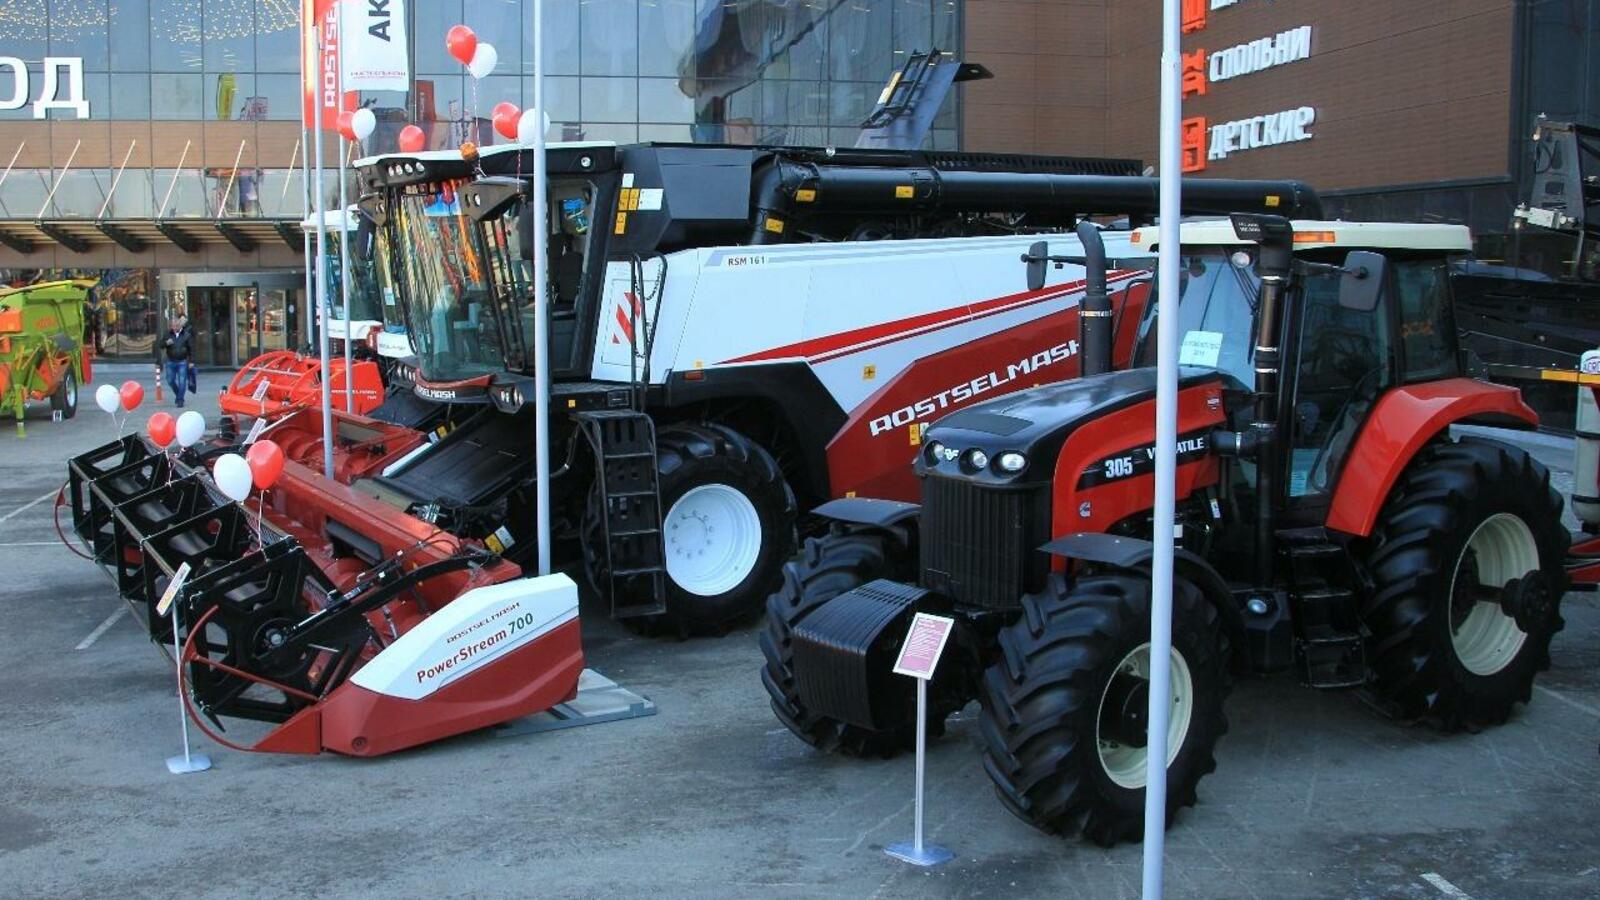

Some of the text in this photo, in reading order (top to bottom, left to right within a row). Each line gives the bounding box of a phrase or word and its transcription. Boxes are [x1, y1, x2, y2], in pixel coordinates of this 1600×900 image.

[728, 256, 765, 266] RSM 161
[1105, 437, 1205, 478] 305 VATILE
[447, 602, 520, 644] ROSTSELMASH
[416, 612, 534, 683] PowerStream 700
